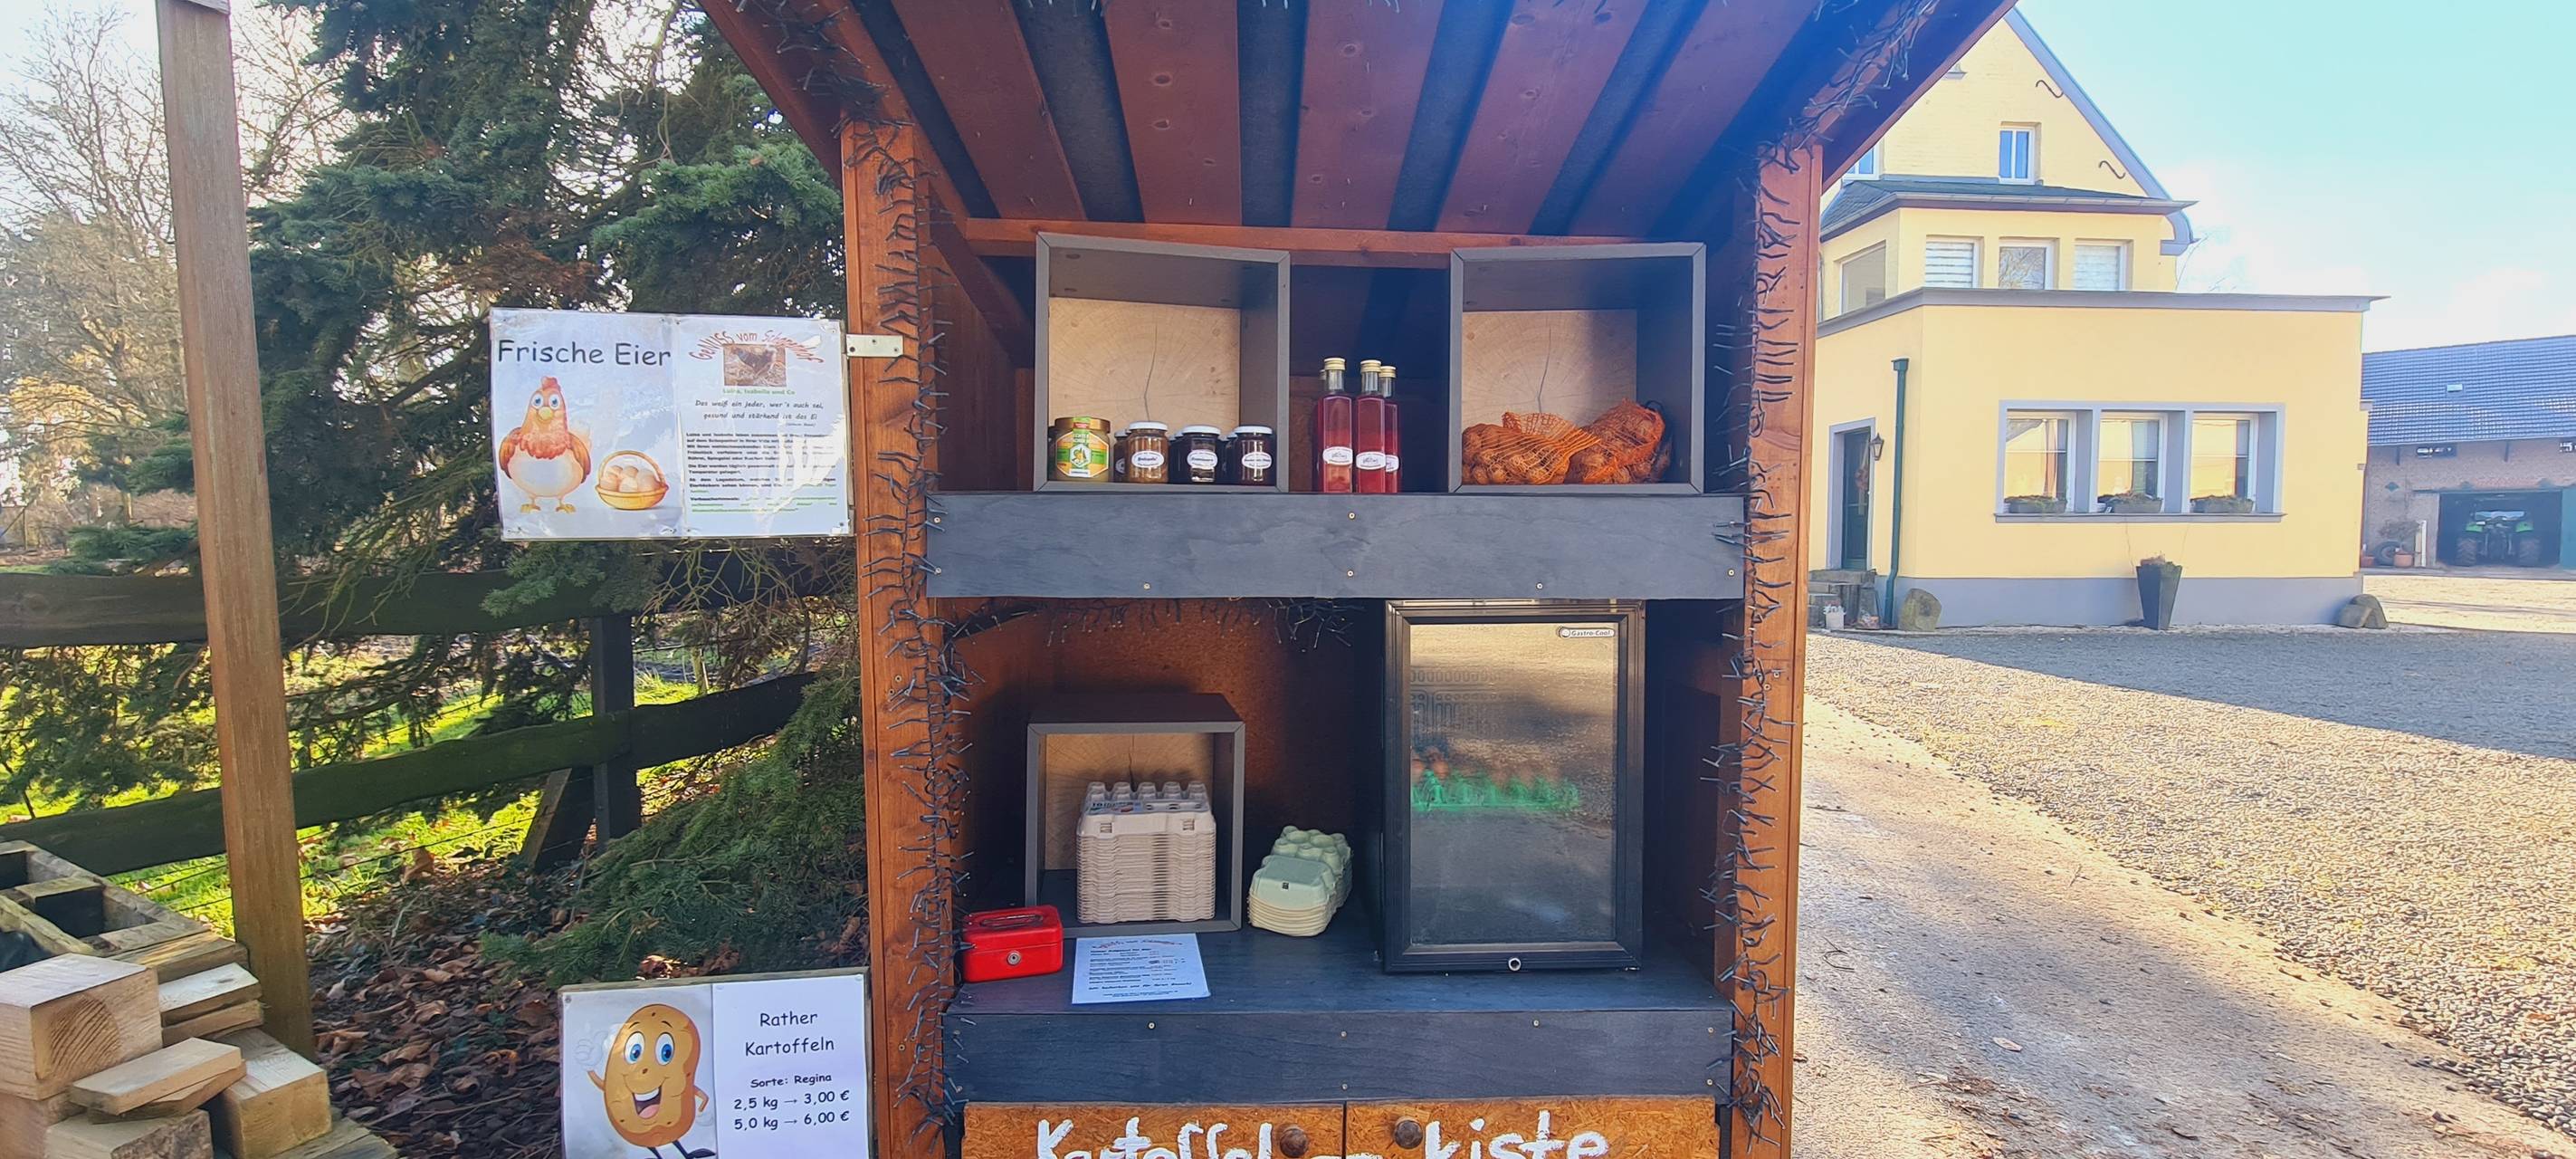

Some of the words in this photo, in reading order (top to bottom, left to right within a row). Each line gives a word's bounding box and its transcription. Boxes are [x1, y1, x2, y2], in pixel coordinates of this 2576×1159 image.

[736, 332, 758, 342] vom
[498, 339, 605, 364] Frische
[615, 341, 672, 367] Eier
[744, 400, 766, 408] jeder,
[703, 412, 729, 420] gesund
[759, 1011, 818, 1027] Rather
[745, 1036, 835, 1057] Kartoffeln
[749, 1078, 788, 1088] Sorte:
[794, 1073, 833, 1086] Regina
[733, 1097, 758, 1111] 2,5
[763, 1096, 778, 1110] kg
[804, 1090, 835, 1106] 3,00
[840, 1089, 850, 1101] €
[734, 1116, 758, 1131] 5,0
[763, 1116, 778, 1130] kg
[804, 1111, 835, 1125] 6,00
[840, 1110, 850, 1122] €
[1037, 1116, 1274, 1159] Ktffl
